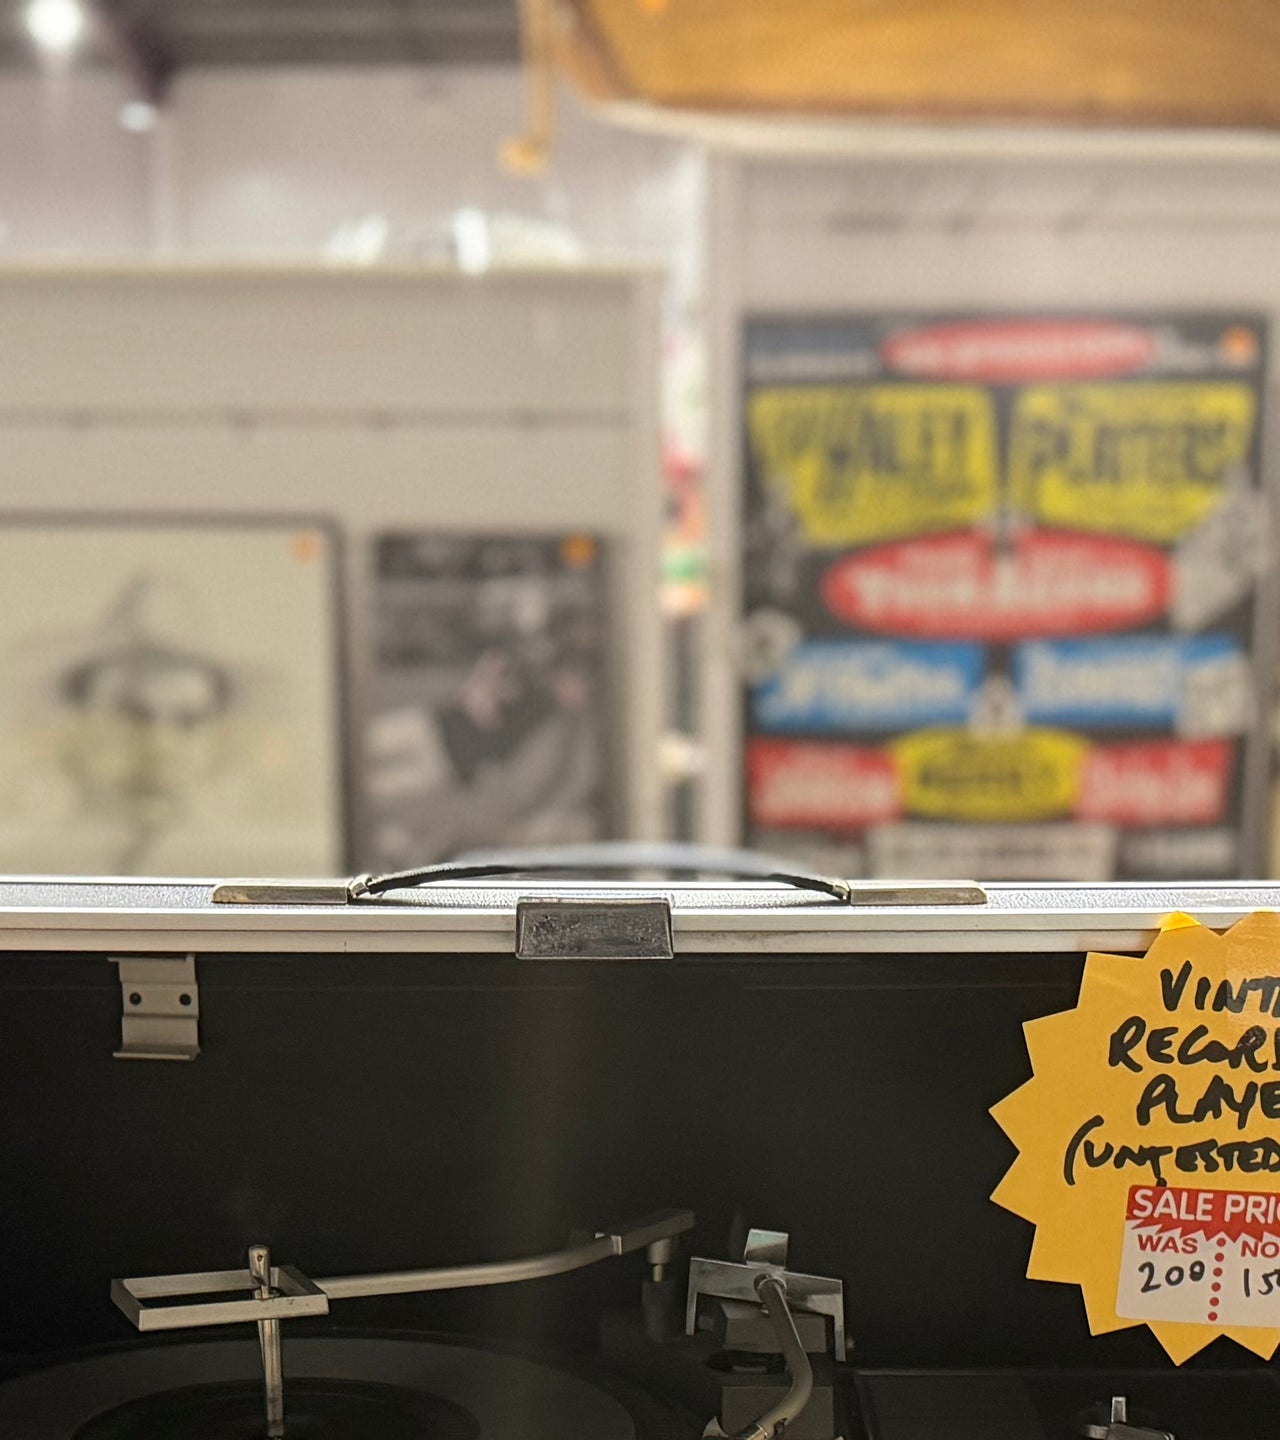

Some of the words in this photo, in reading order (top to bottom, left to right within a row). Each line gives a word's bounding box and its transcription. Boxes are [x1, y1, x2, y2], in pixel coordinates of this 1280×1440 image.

[1133, 1188, 1213, 1222] SALE
[1137, 1234, 1198, 1254] WAS
[1139, 1261, 1205, 1293] 200
